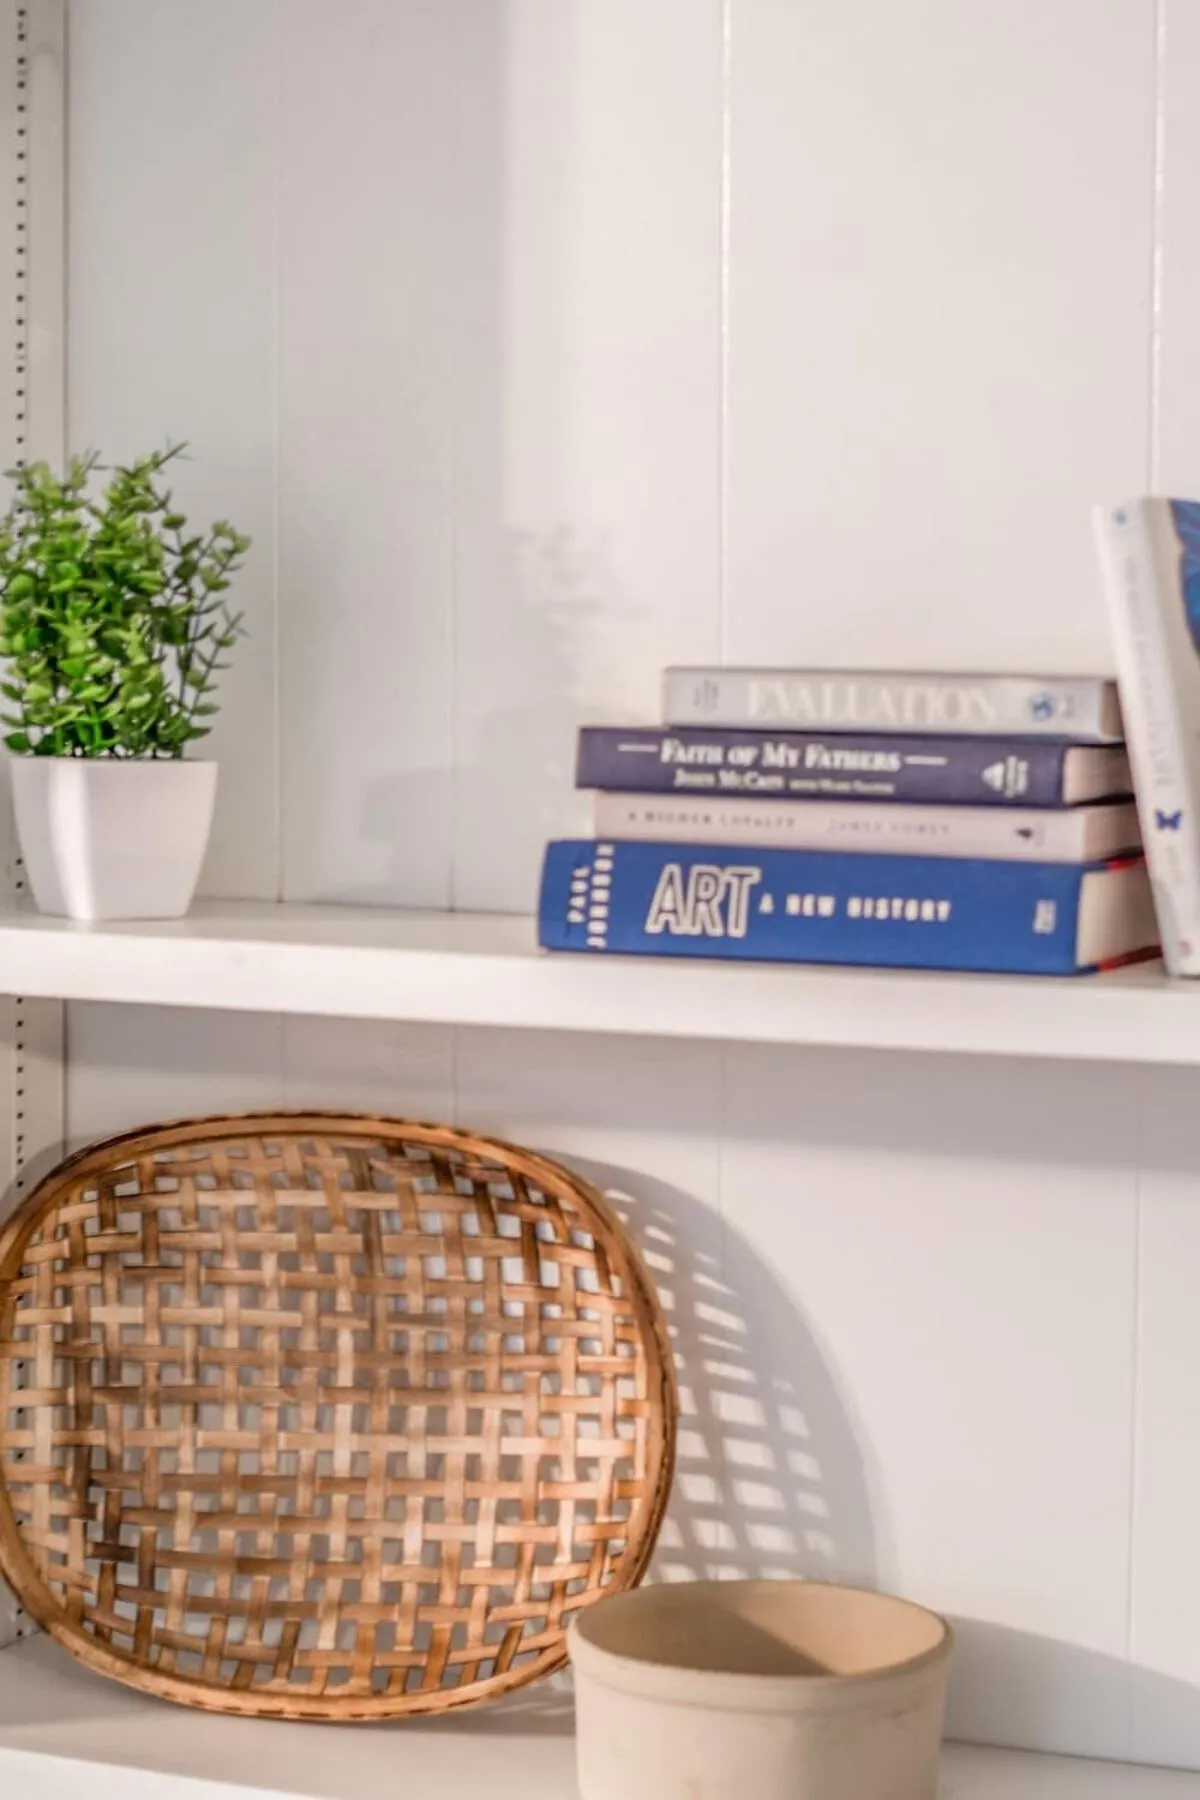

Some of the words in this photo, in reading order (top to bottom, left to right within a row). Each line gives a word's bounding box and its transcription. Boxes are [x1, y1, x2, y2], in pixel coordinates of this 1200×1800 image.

[567, 866, 590, 924] PAUL
[586, 843, 615, 950] JOHNSON
[645, 863, 762, 938] ART
[759, 893, 774, 915] A
[786, 894, 835, 917] NEW
[847, 896, 952, 922] HISTORY
